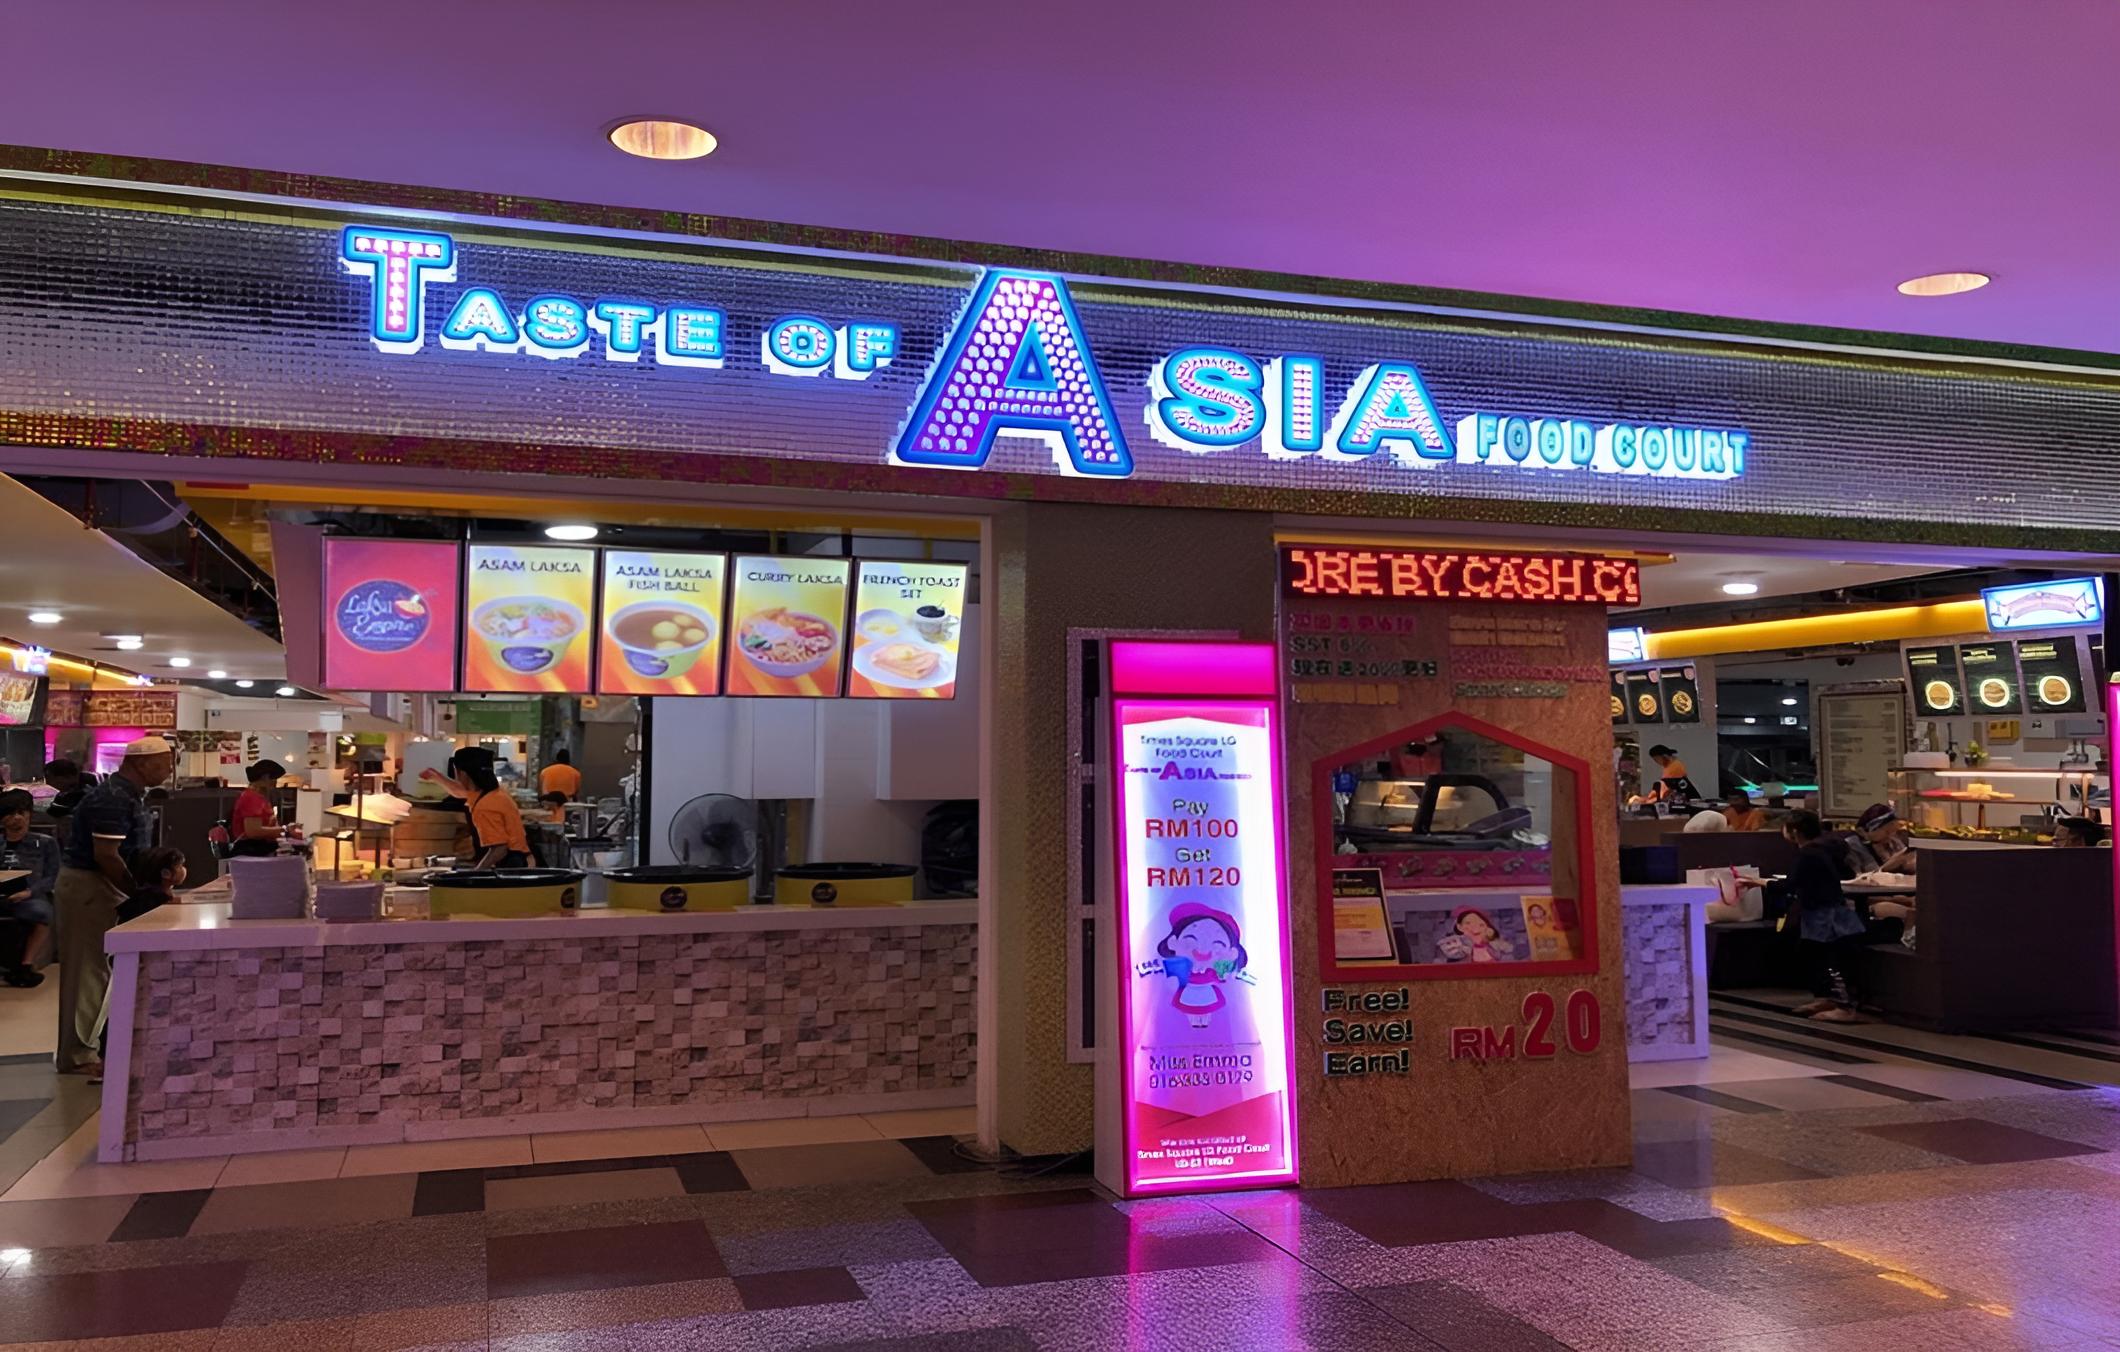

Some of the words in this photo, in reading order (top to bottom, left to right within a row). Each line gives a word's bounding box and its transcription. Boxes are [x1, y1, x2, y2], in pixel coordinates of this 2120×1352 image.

[343, 225, 726, 361] TASTE
[769, 315, 900, 371] OF
[893, 267, 1456, 477] ASIA
[1476, 412, 1596, 465] FOOD
[1611, 422, 1747, 474] COURT
[478, 559, 525, 572] ASAM
[530, 561, 582, 573] LAKSA
[615, 565, 660, 577] ASAM
[664, 566, 713, 579] LAKSA
[797, 572, 844, 584] LAKSA
[1391, 556, 1450, 596] BY
[1462, 556, 1585, 599] CASH
[1172, 799, 1209, 817] Pay
[1145, 818, 1239, 838] RM100
[1175, 847, 1211, 862] Get
[1146, 867, 1241, 887] RM120
[1322, 1018, 1414, 1045] Save!
[1323, 1047, 1410, 1077] Earn!
